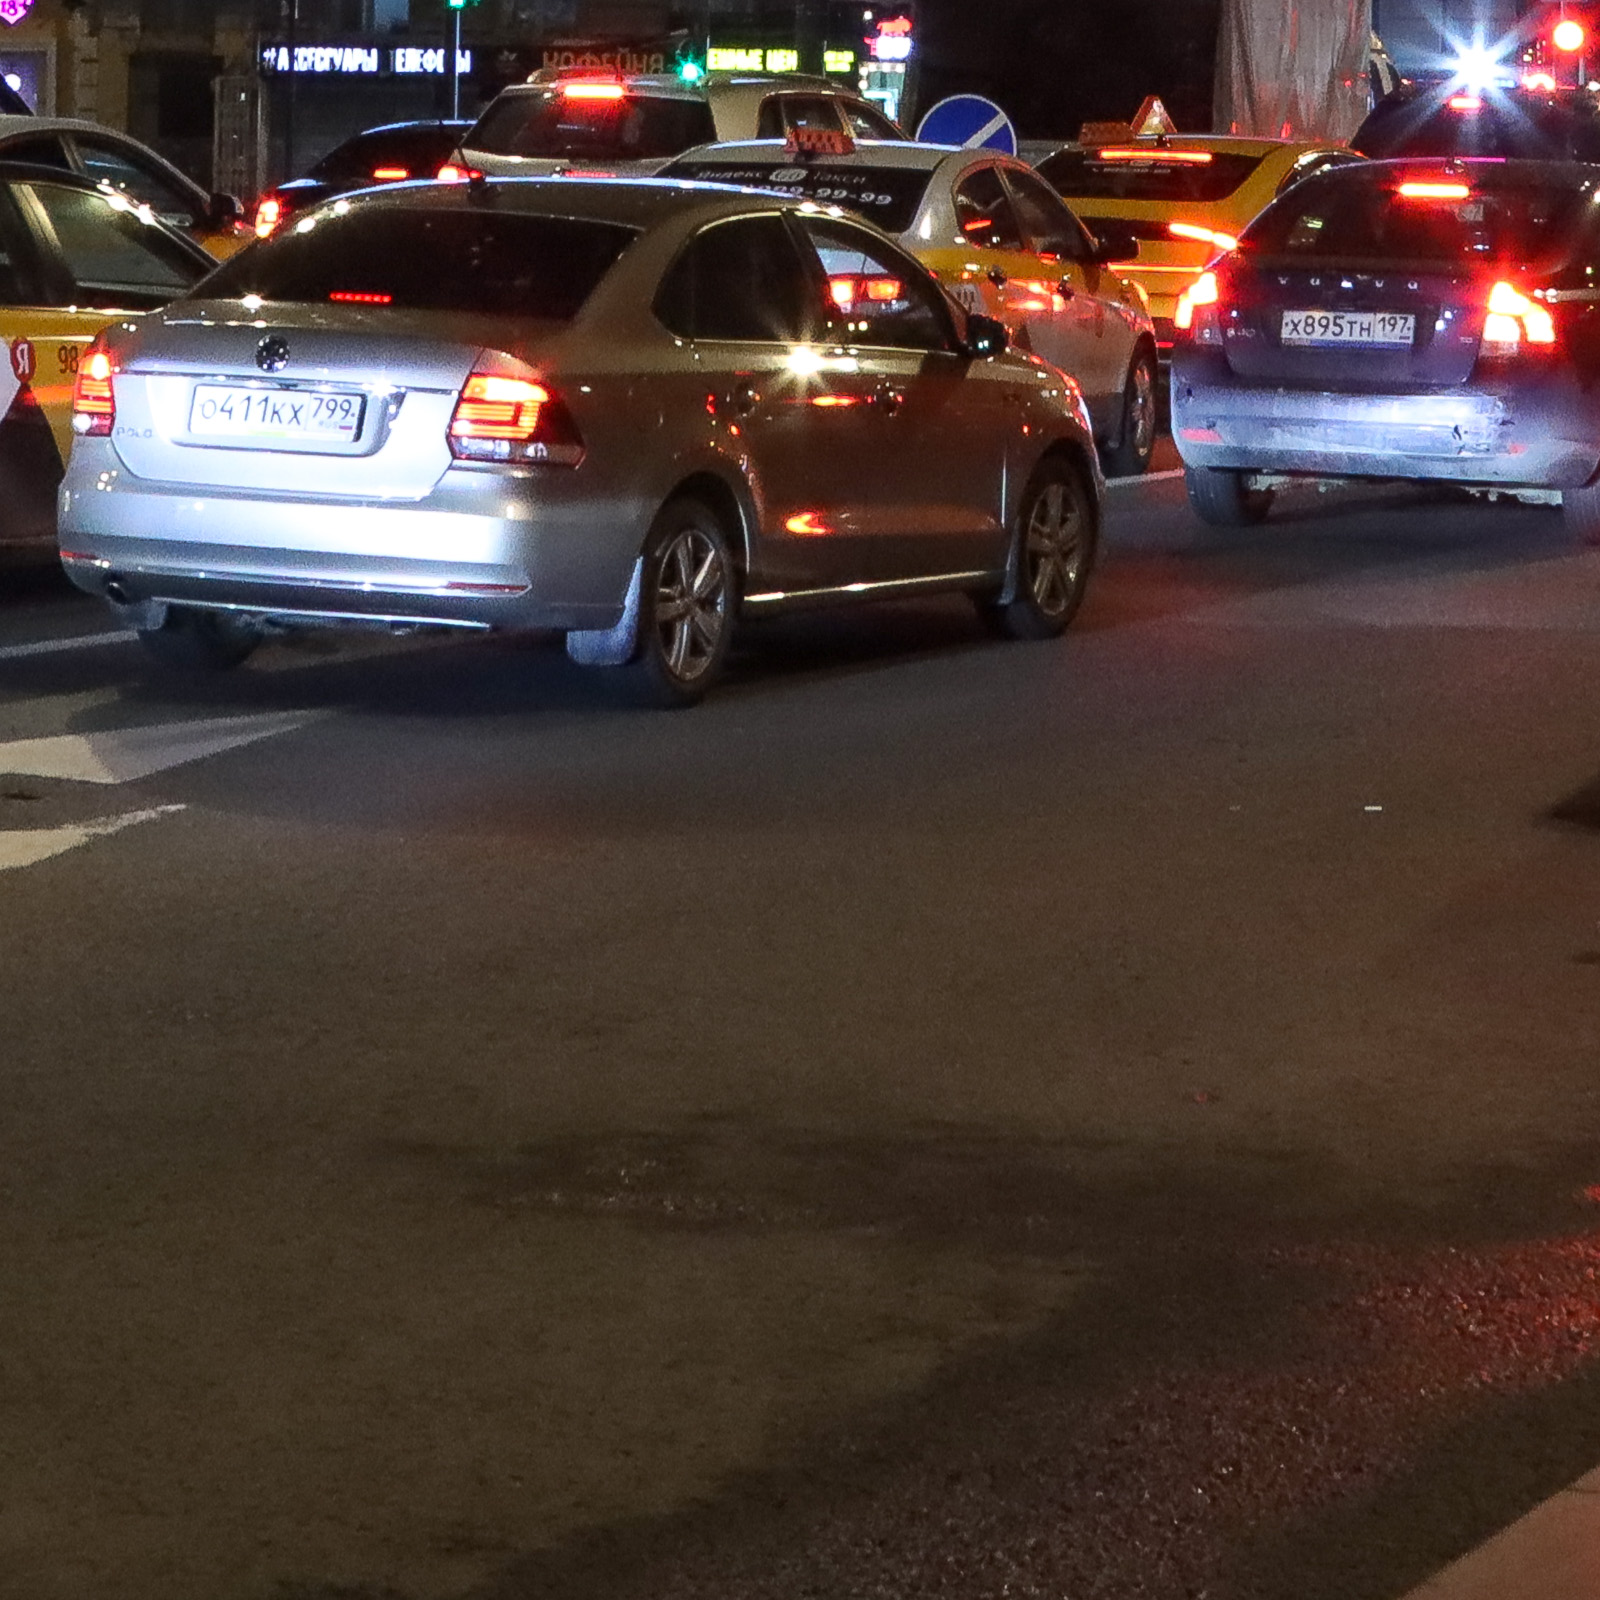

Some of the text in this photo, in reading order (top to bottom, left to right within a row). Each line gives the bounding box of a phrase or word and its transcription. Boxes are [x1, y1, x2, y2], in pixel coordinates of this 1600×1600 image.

[1289, 314, 1410, 339] Х895ТН 197
[200, 393, 353, 426] О411КХ 799
[116, 425, 153, 439] POLO
